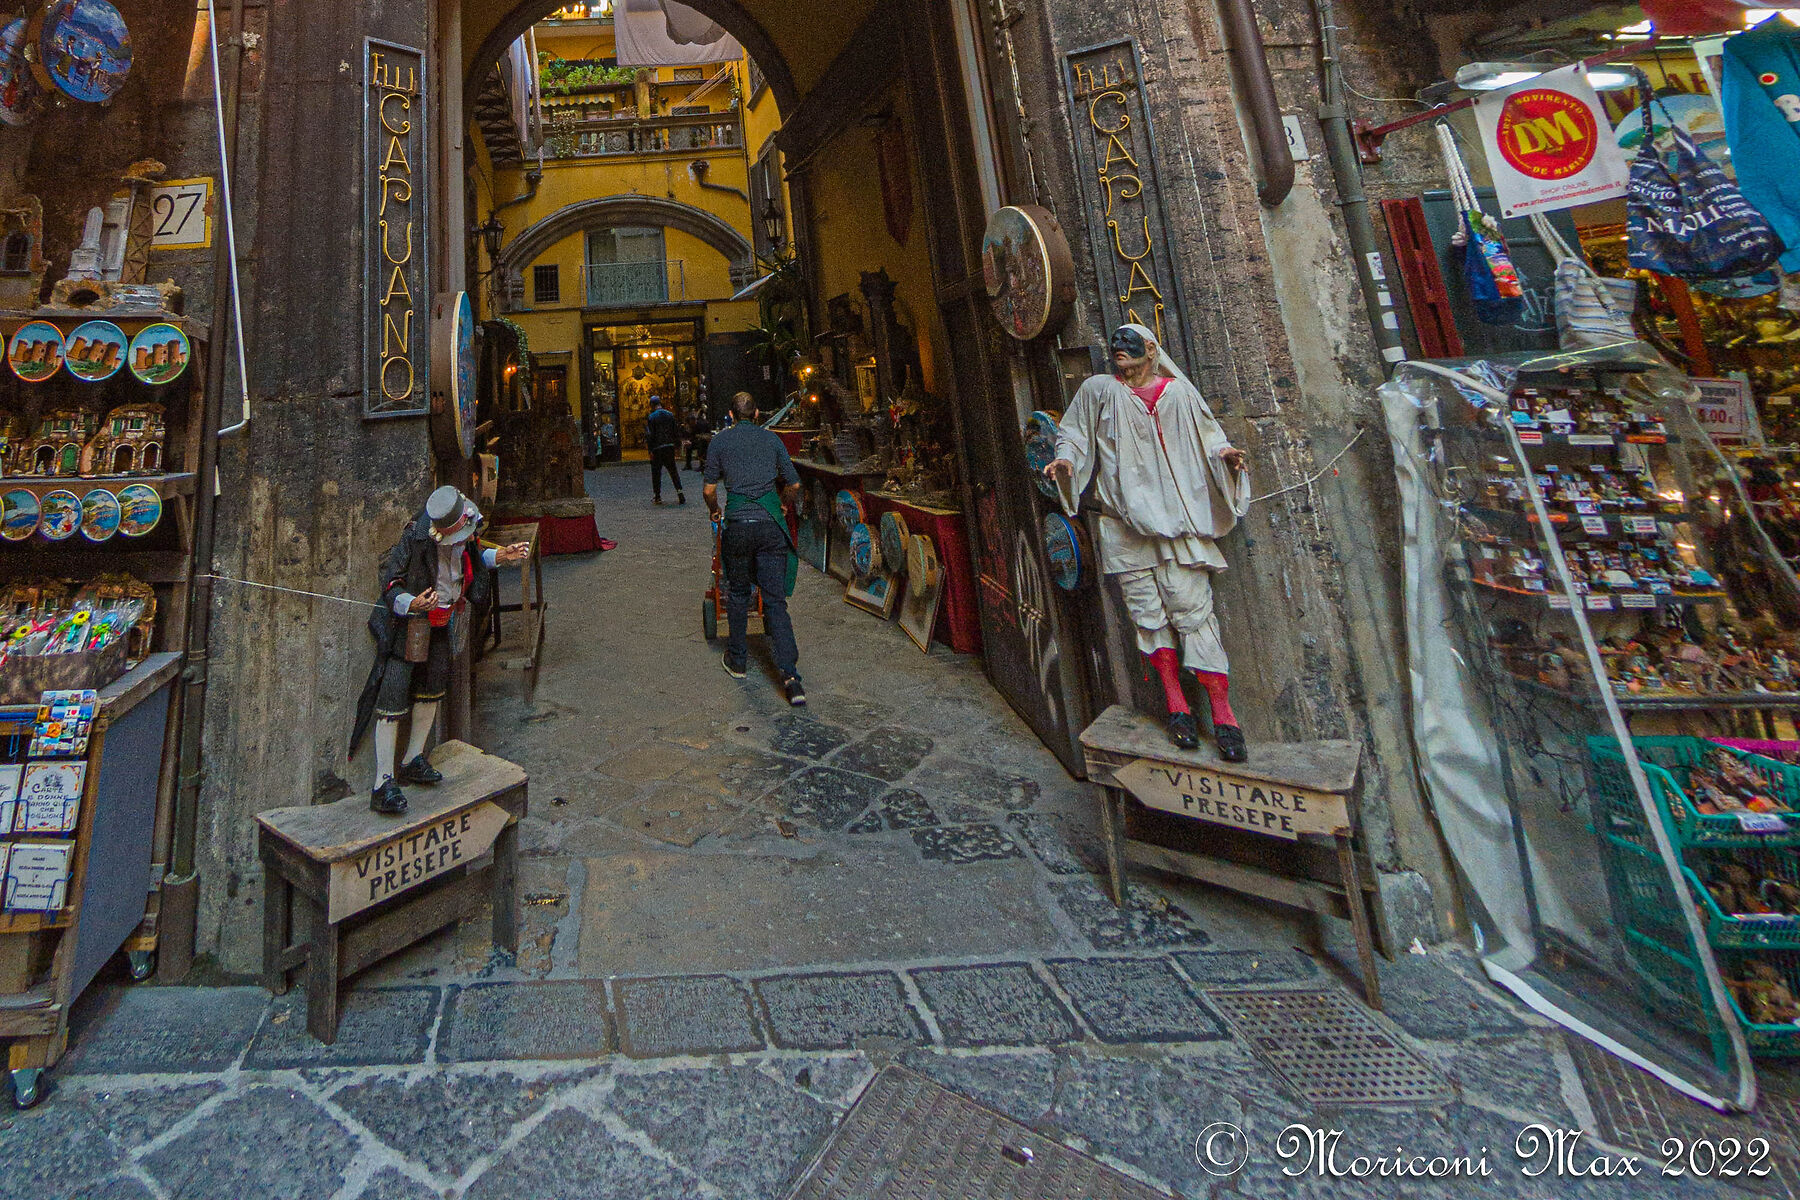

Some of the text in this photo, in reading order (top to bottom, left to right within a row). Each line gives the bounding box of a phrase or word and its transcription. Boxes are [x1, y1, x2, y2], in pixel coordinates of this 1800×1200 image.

[1512, 110, 1585, 155] DM
[1532, 157, 1585, 175] DE MARIA
[153, 192, 202, 237] 27
[1091, 91, 1164, 346] CAPUAN
[379, 93, 414, 401] CAPUANO
[1165, 768, 1307, 813] VISITARE
[1182, 793, 1294, 833] PRESEPE
[355, 813, 471, 879] VISITARE
[369, 840, 462, 901] PRESEPE
